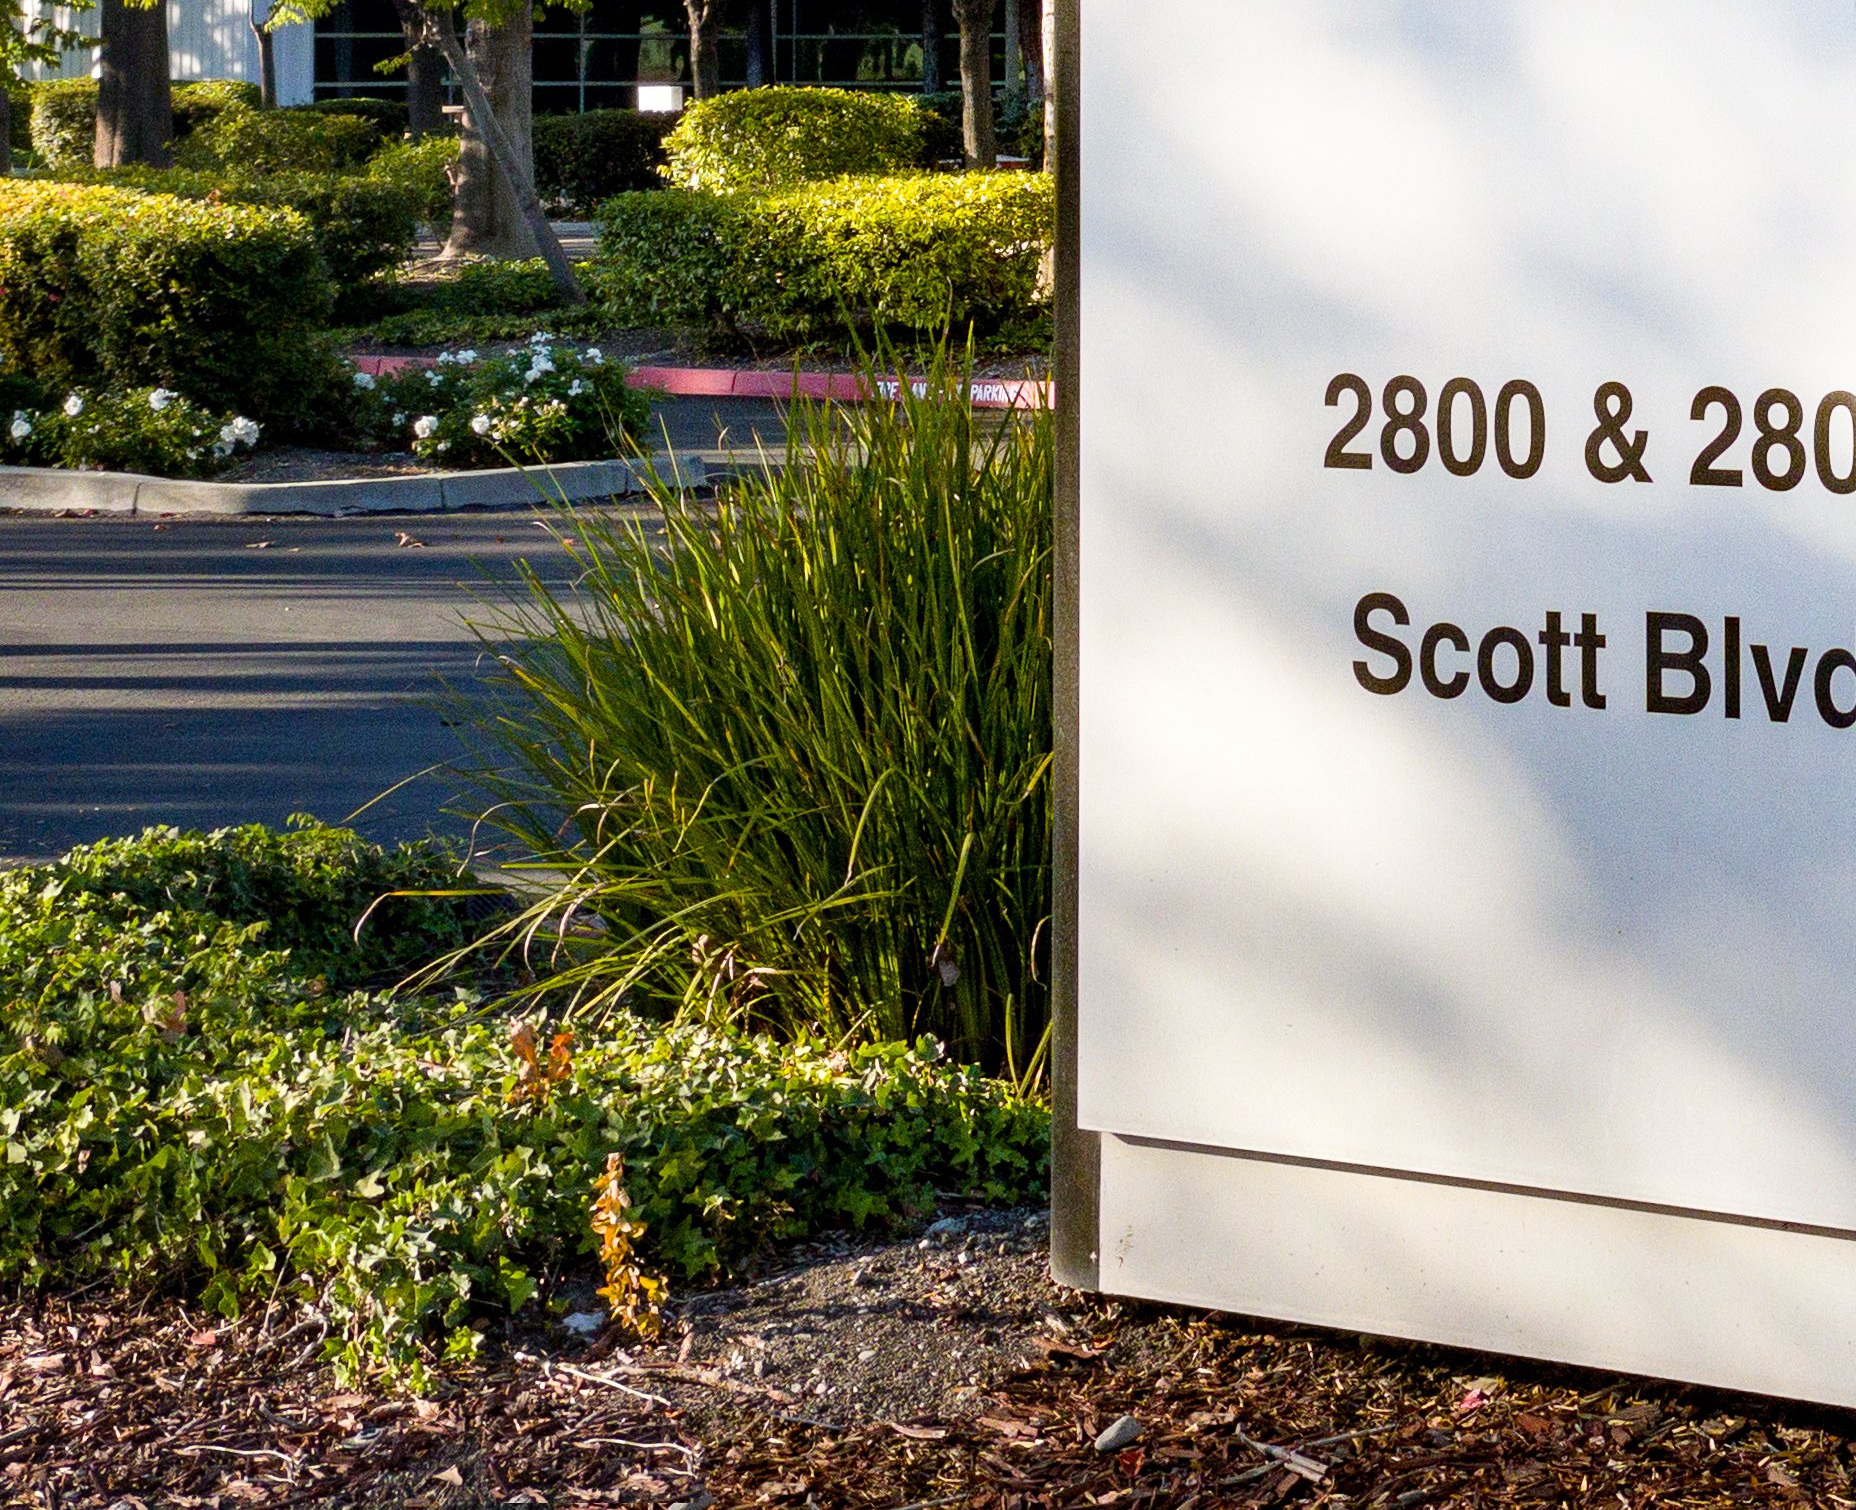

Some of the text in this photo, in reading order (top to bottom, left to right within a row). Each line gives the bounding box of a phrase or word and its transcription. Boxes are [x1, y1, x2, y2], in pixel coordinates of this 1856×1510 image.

[970, 383, 1020, 402] PARKING
[1324, 373, 1546, 480] 2800
[1584, 381, 1653, 484] &
[1352, 592, 1607, 710] Scott
